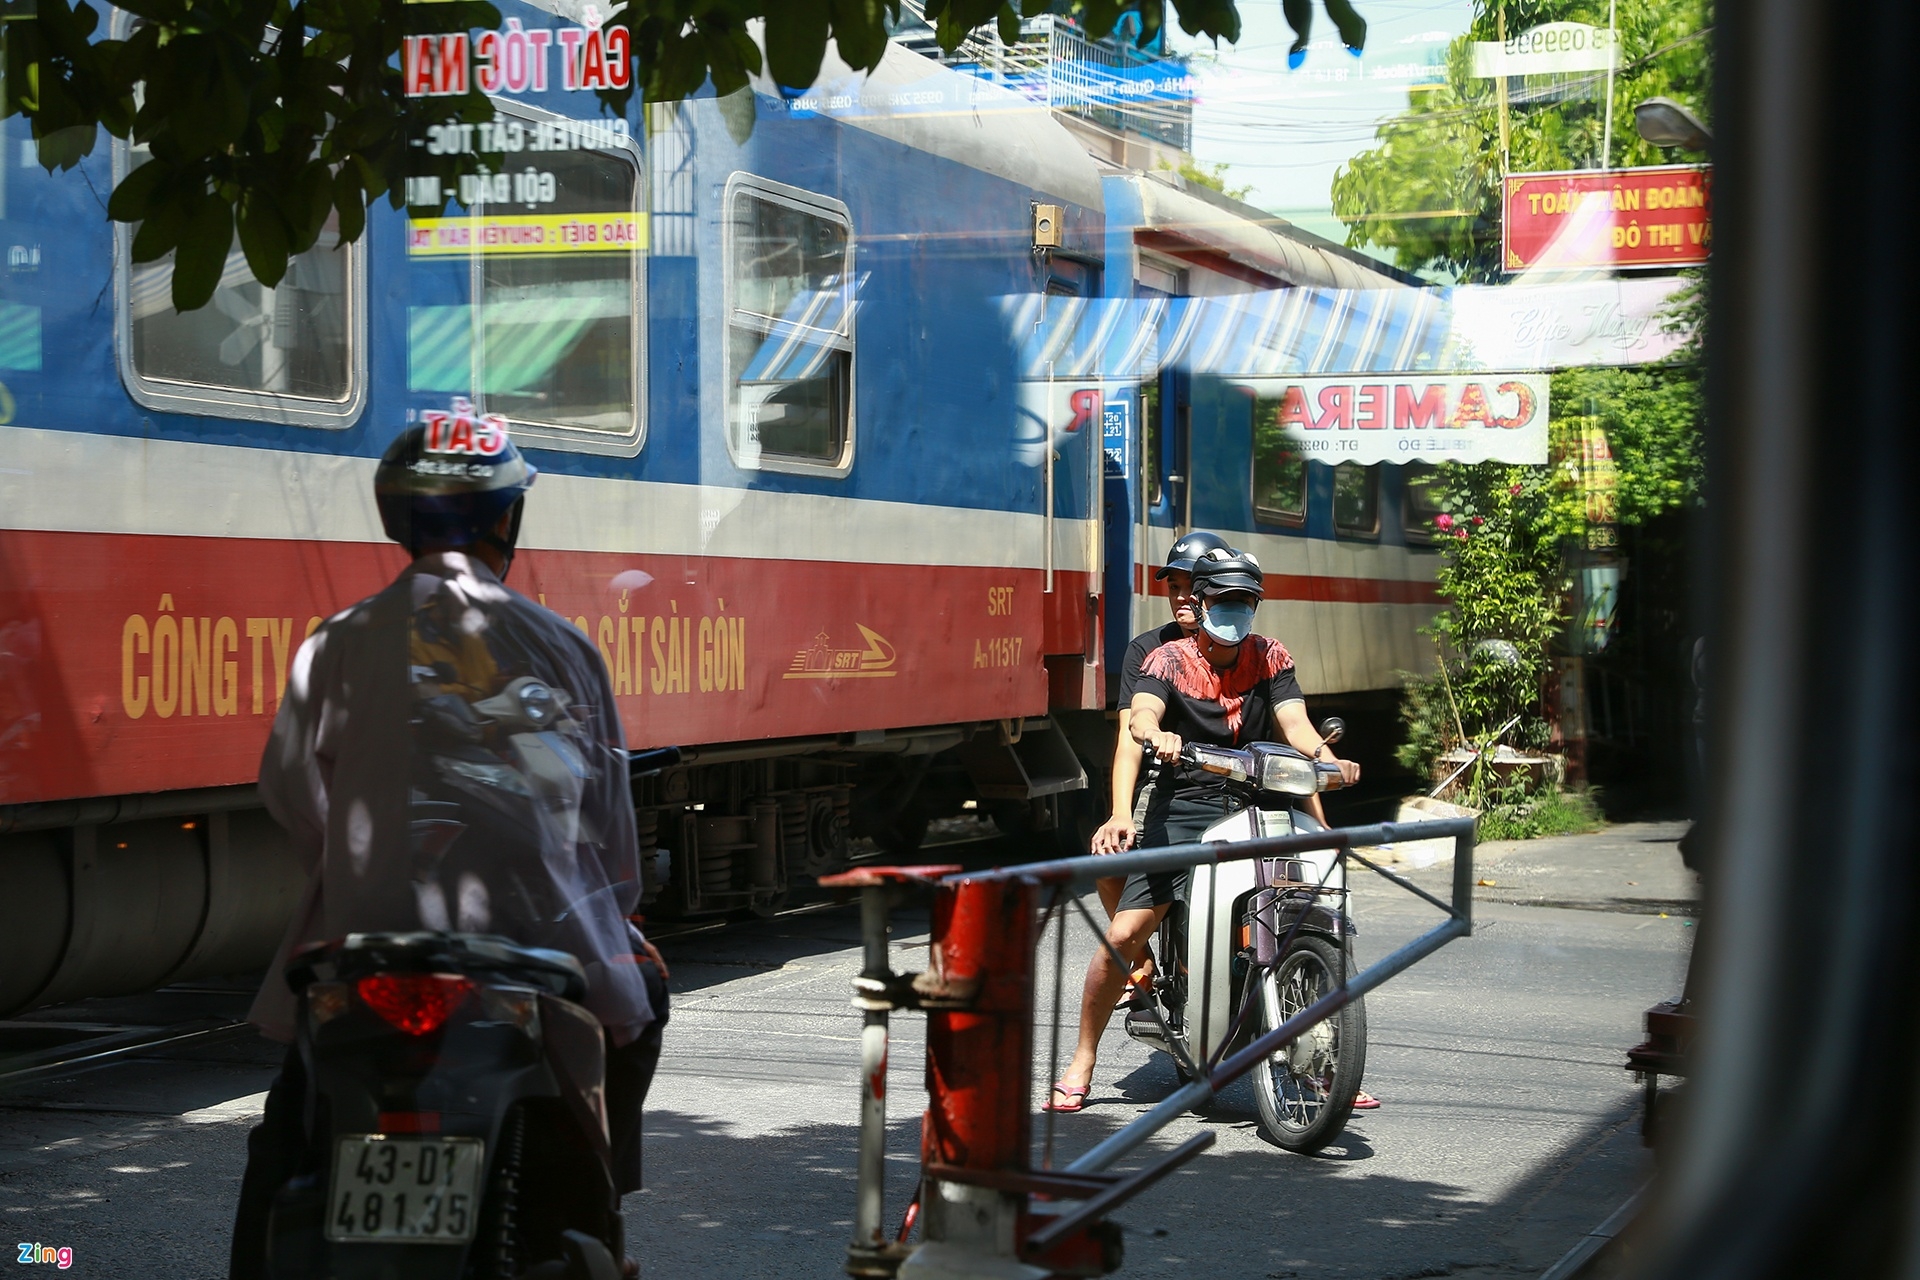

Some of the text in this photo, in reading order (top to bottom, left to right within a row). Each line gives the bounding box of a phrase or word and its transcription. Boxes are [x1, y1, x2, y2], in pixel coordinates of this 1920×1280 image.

[987, 586, 1014, 617] SRT
[121, 593, 293, 720] CÔNG TY
[597, 588, 646, 696] SẮT
[650, 599, 691, 696] SÀI
[698, 597, 745, 694] GÒN
[834, 652, 859, 669] SRT
